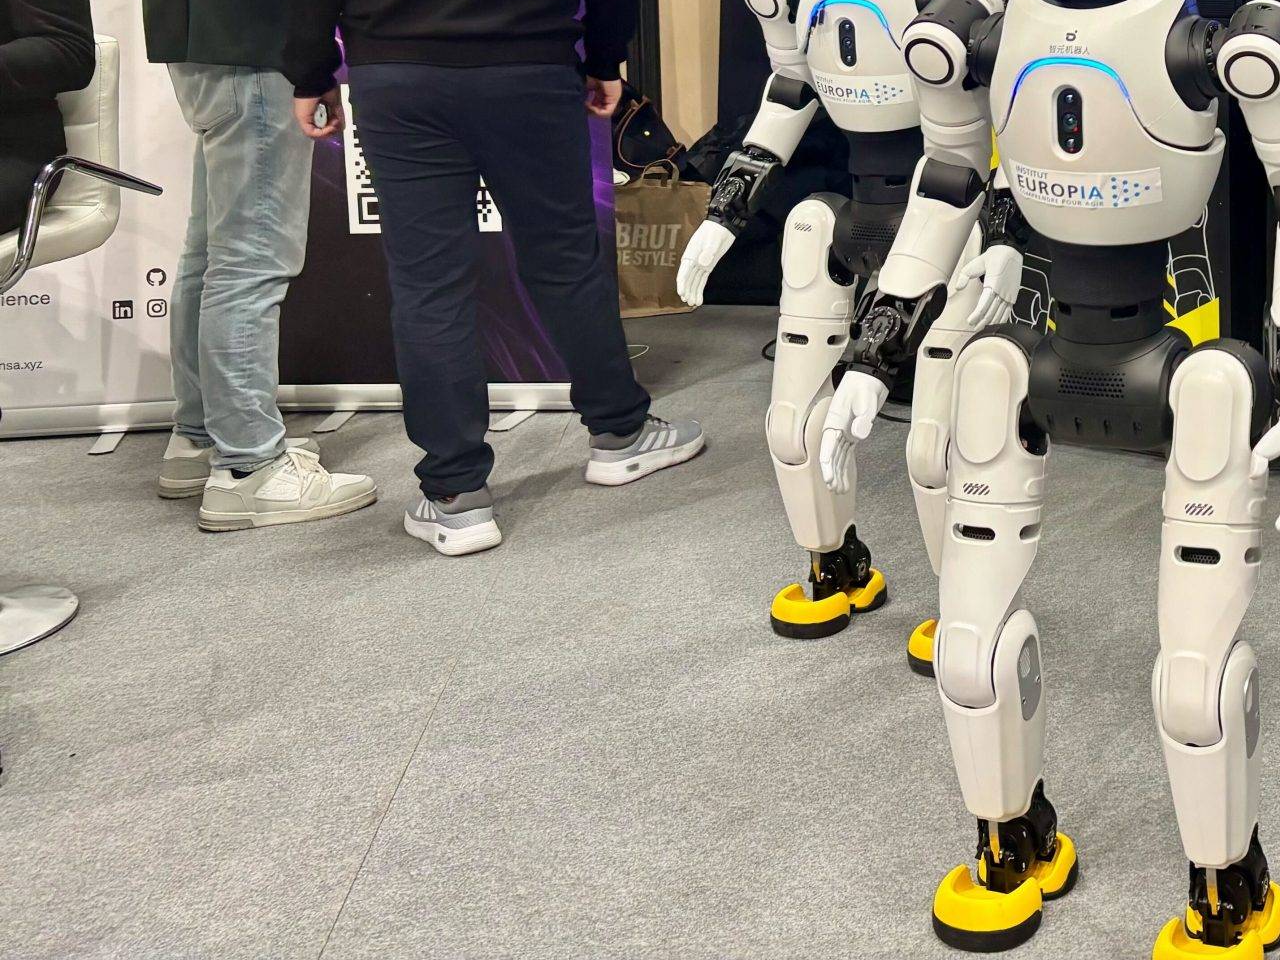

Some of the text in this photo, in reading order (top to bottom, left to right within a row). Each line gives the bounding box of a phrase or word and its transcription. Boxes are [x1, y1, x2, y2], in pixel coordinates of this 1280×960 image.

[816, 81, 870, 100] EUROPIA
[1015, 164, 1048, 179] INSTITUT
[1017, 174, 1104, 200] EUROPIA
[616, 222, 681, 249] BRUT
[632, 250, 677, 267] STYLE
